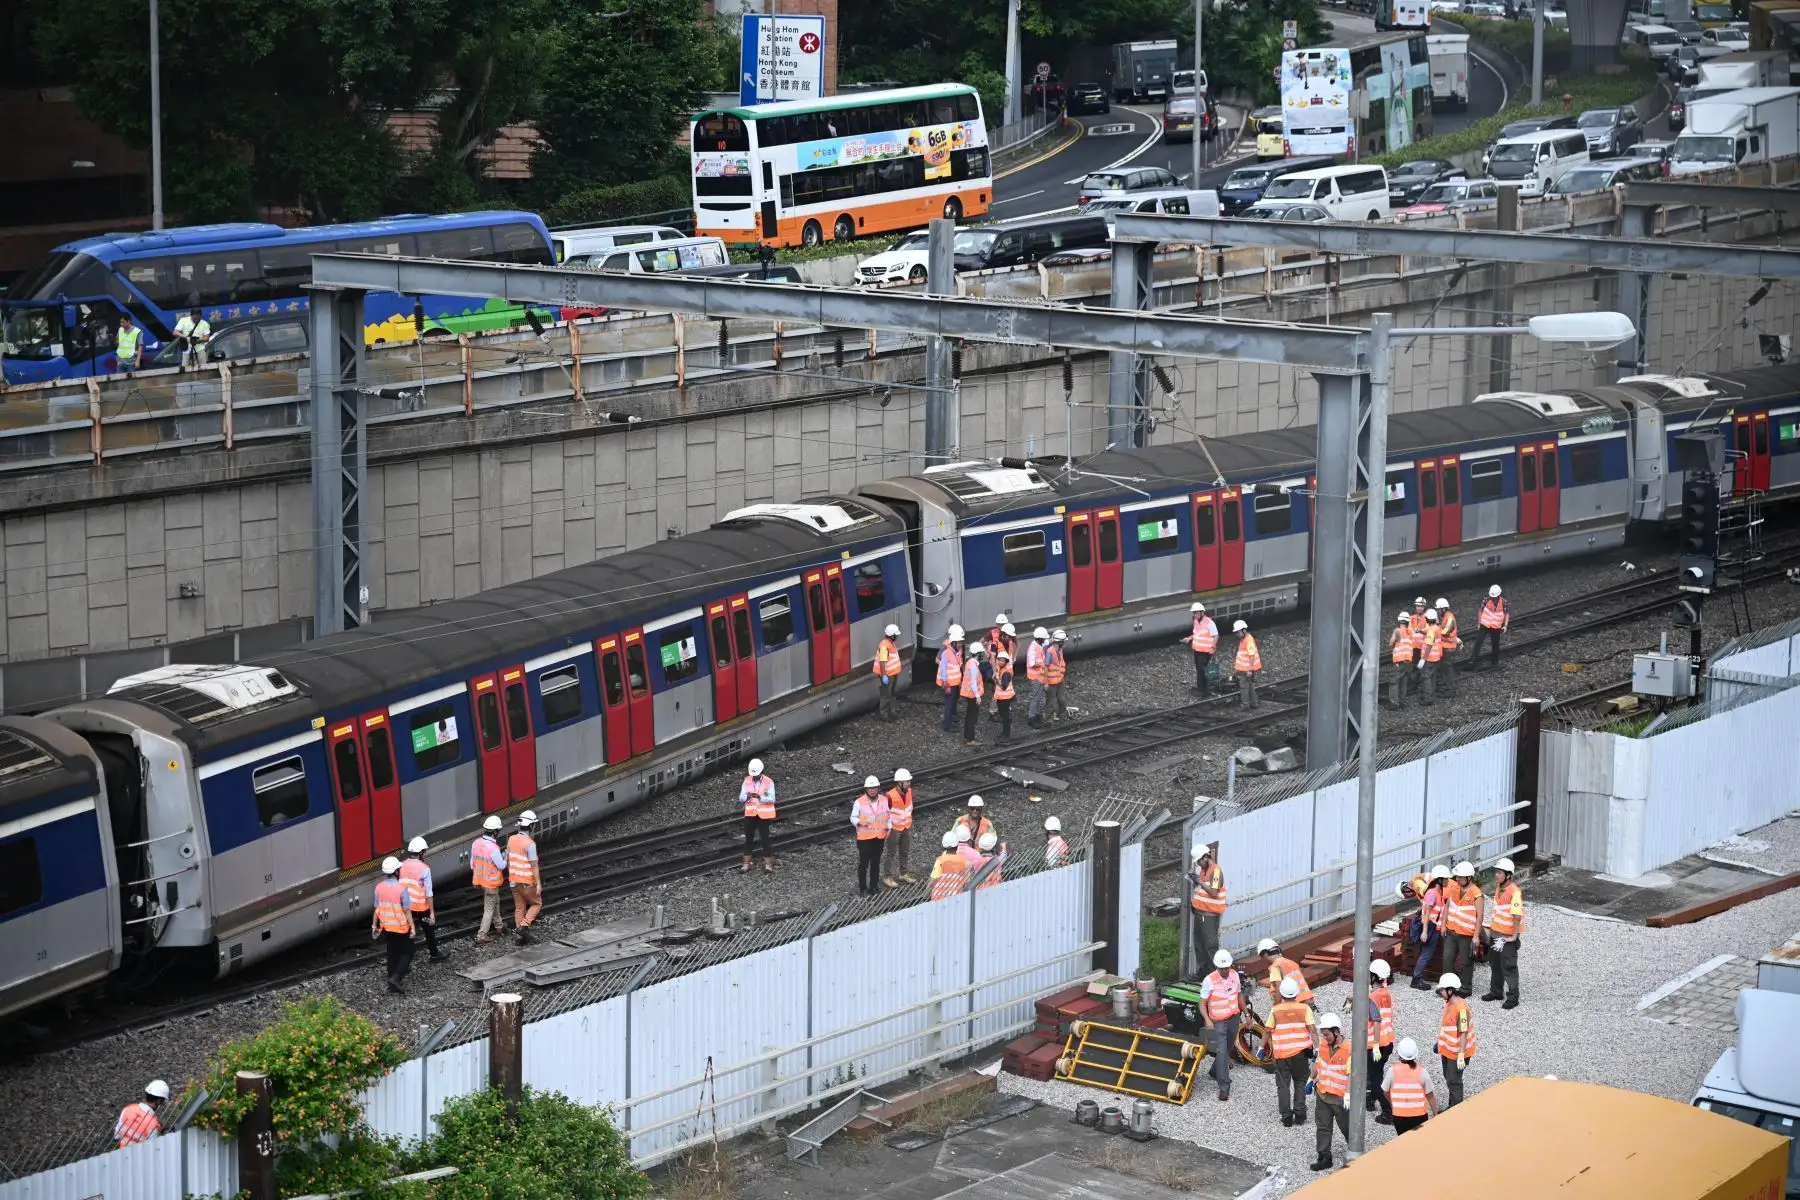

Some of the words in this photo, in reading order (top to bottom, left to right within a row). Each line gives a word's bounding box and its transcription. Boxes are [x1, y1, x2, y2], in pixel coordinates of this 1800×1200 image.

[761, 25, 781, 33] Hug
[766, 34, 793, 42] Sation
[779, 60, 798, 68] Kong
[761, 67, 794, 76] Colseum
[928, 130, 947, 147] 6GB
